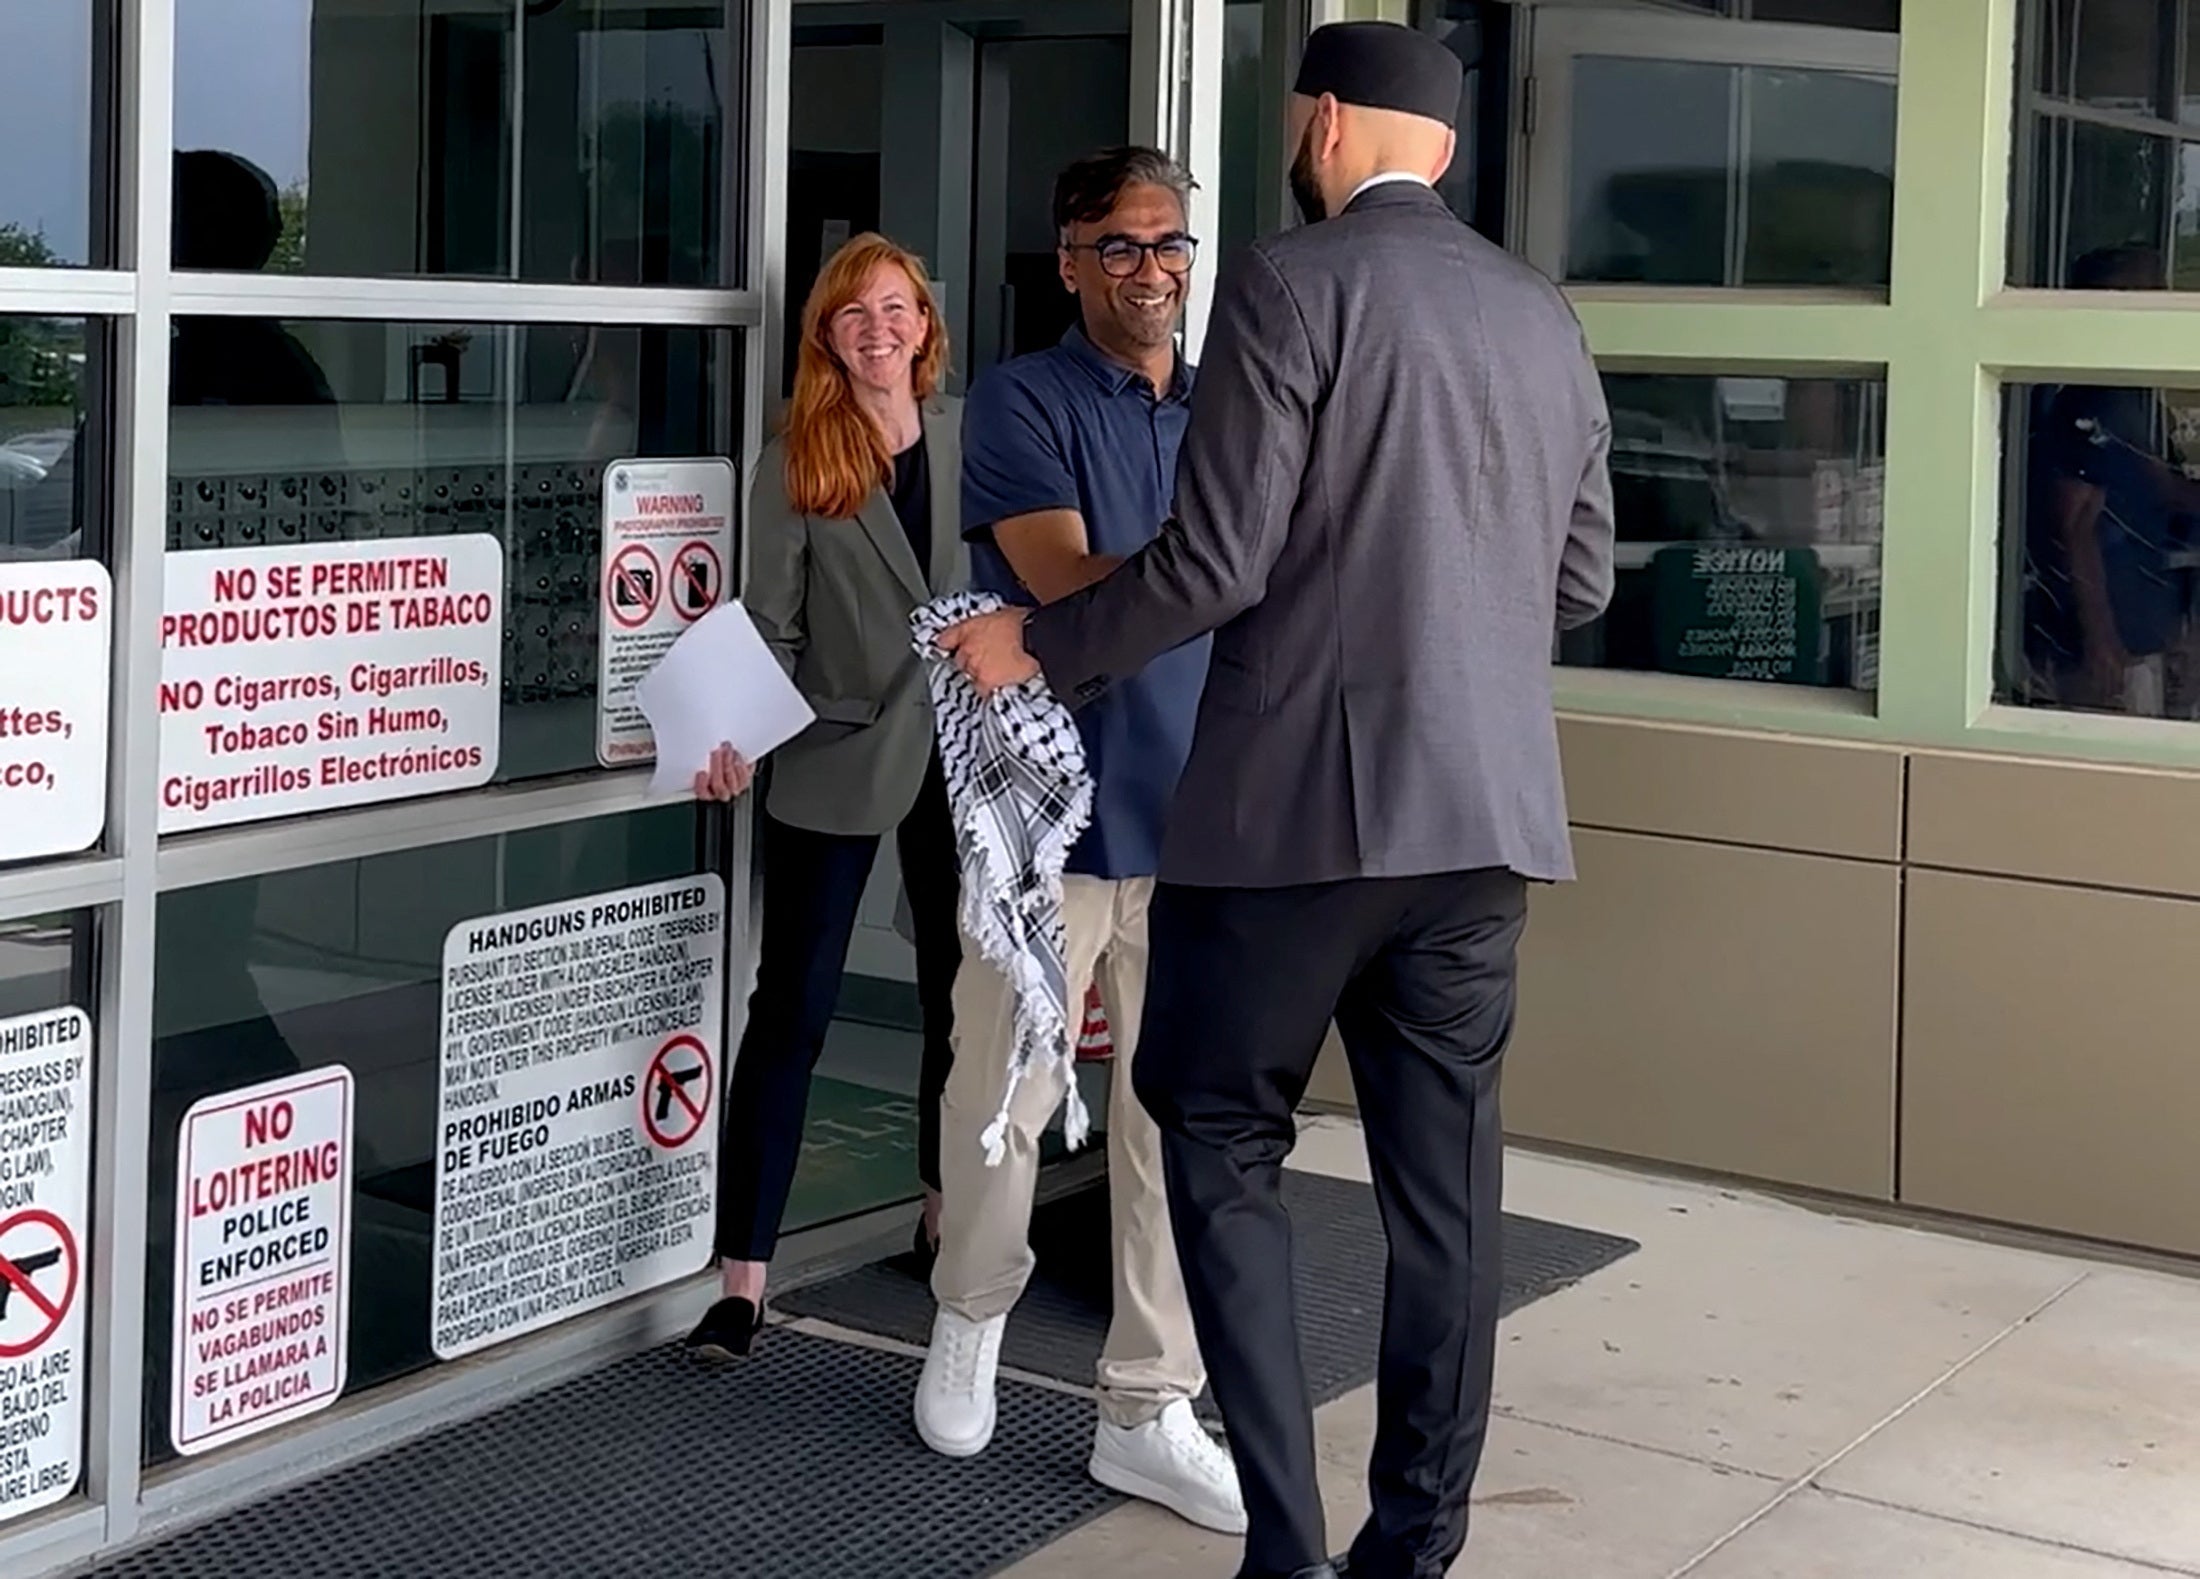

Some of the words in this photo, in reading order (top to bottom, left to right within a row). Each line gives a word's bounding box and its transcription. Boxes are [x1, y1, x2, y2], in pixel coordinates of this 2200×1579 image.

[636, 494, 704, 514] WARNING
[0, 587, 97, 625] UCTS
[215, 569, 256, 602] NO
[267, 566, 301, 599] SE
[312, 558, 448, 595] PERMITEN
[162, 603, 336, 647] PRODUCTOS
[347, 601, 381, 633] DE
[390, 594, 491, 629] TABACO
[160, 681, 203, 712] NO
[215, 674, 341, 710] Cigarros,
[351, 658, 488, 696] Cigarrillos,
[206, 722, 308, 754] Tobaco
[318, 712, 358, 740] Sin
[369, 707, 448, 735] Humo,
[0, 761, 54, 790] co,
[164, 765, 310, 811] Cigarrillos
[321, 745, 481, 785] Electrónicos
[469, 910, 585, 952] HANDGUNS
[591, 886, 706, 927] PROHIBITED
[448, 957, 505, 987] PURSUANT
[507, 954, 520, 975] TO
[523, 944, 567, 971] SECTION
[596, 932, 626, 956] PENAL
[628, 926, 655, 949] CODE
[707, 913, 719, 932] BY
[447, 984, 492, 1012] LICENSE
[495, 974, 538, 1001] HOLDER
[539, 968, 565, 991] WITH
[567, 966, 573, 985] A
[576, 953, 636, 983] CONCEALED
[447, 1017, 454, 1037] A
[457, 1006, 500, 1035] PERSON
[503, 995, 552, 1024] LICENSED
[554, 986, 589, 1012] UNDER
[592, 971, 656, 1003] SUBCHAPTER
[670, 959, 712, 985] CHAPTER
[0, 1015, 81, 1053] HIBITED
[444, 1063, 467, 1086] MAY
[469, 1057, 492, 1080] NOT
[494, 1048, 529, 1074] ENTER
[531, 1042, 554, 1065] THIS
[555, 1028, 608, 1059] PROPERTY
[611, 1022, 635, 1045] WITH
[637, 1020, 643, 1038] A
[645, 1006, 702, 1036] CONCEALED
[467, 1021, 540, 1056] GOVERNMENT
[543, 1014, 571, 1038] CODE
[628, 989, 678, 1017] LICENSING
[65, 1056, 84, 1081] BY
[1, 1116, 67, 1152] CHAPTER
[245, 1101, 293, 1148] NO
[445, 1094, 560, 1144] PROHIBIDO
[566, 1075, 635, 1111] ARMAS
[441, 1179, 455, 1201] DE
[458, 1165, 506, 1196] ACUERDO
[510, 1157, 532, 1181] CON
[533, 1153, 545, 1174] LA
[617, 1128, 634, 1150] DEL
[444, 1146, 471, 1172] DE
[478, 1124, 549, 1162] FUEGO
[192, 1142, 338, 1217] LOITERING
[440, 1229, 453, 1251] DE
[455, 1224, 470, 1247] UN
[472, 1211, 513, 1241] TITULAR
[515, 1206, 527, 1228] DE
[529, 1200, 549, 1223] UNA
[551, 1186, 593, 1216] LICENCIA
[595, 1180, 614, 1203] CON
[616, 1173, 635, 1196] UNA
[637, 1162, 672, 1189] PISTOLA
[483, 1186, 516, 1213] PENAL
[223, 1196, 310, 1243] POLICE
[439, 1251, 461, 1276] UNA
[463, 1235, 511, 1268] PERSONA
[514, 1228, 535, 1252] CON
[536, 1213, 581, 1245] LICENCIA
[617, 1198, 629, 1219] EL
[547, 1241, 567, 1264] DEL
[568, 1226, 613, 1257] GOBIERNO
[636, 1209, 666, 1235] SOBRE
[667, 1194, 710, 1225] LICENCIAS
[200, 1226, 329, 1286] ENFORCED
[438, 1299, 465, 1325] PARA
[467, 1284, 508, 1315] PORTAR
[564, 1260, 579, 1282] NO
[581, 1249, 613, 1276] PUEDE
[615, 1233, 662, 1265] INGRESAR
[670, 1222, 694, 1246] ESTA
[192, 1308, 219, 1335] NO
[225, 1298, 248, 1323] SE
[254, 1271, 333, 1315] PERMITE
[437, 1312, 495, 1350] PROPIEDAD
[498, 1304, 520, 1329] CON
[522, 1296, 542, 1321] UNA
[544, 1281, 586, 1313] PISTOLA
[199, 1305, 324, 1363] VAGABUNDOS
[19, 1360, 36, 1387] AL
[40, 1349, 70, 1379] AIRE
[194, 1372, 219, 1398] SE
[224, 1345, 308, 1389] LLAMARA
[315, 1335, 327, 1357] A
[3, 1387, 39, 1420] BAJO
[42, 1380, 67, 1407] DEL
[210, 1397, 233, 1424] LA
[239, 1371, 311, 1414] POLICIA
